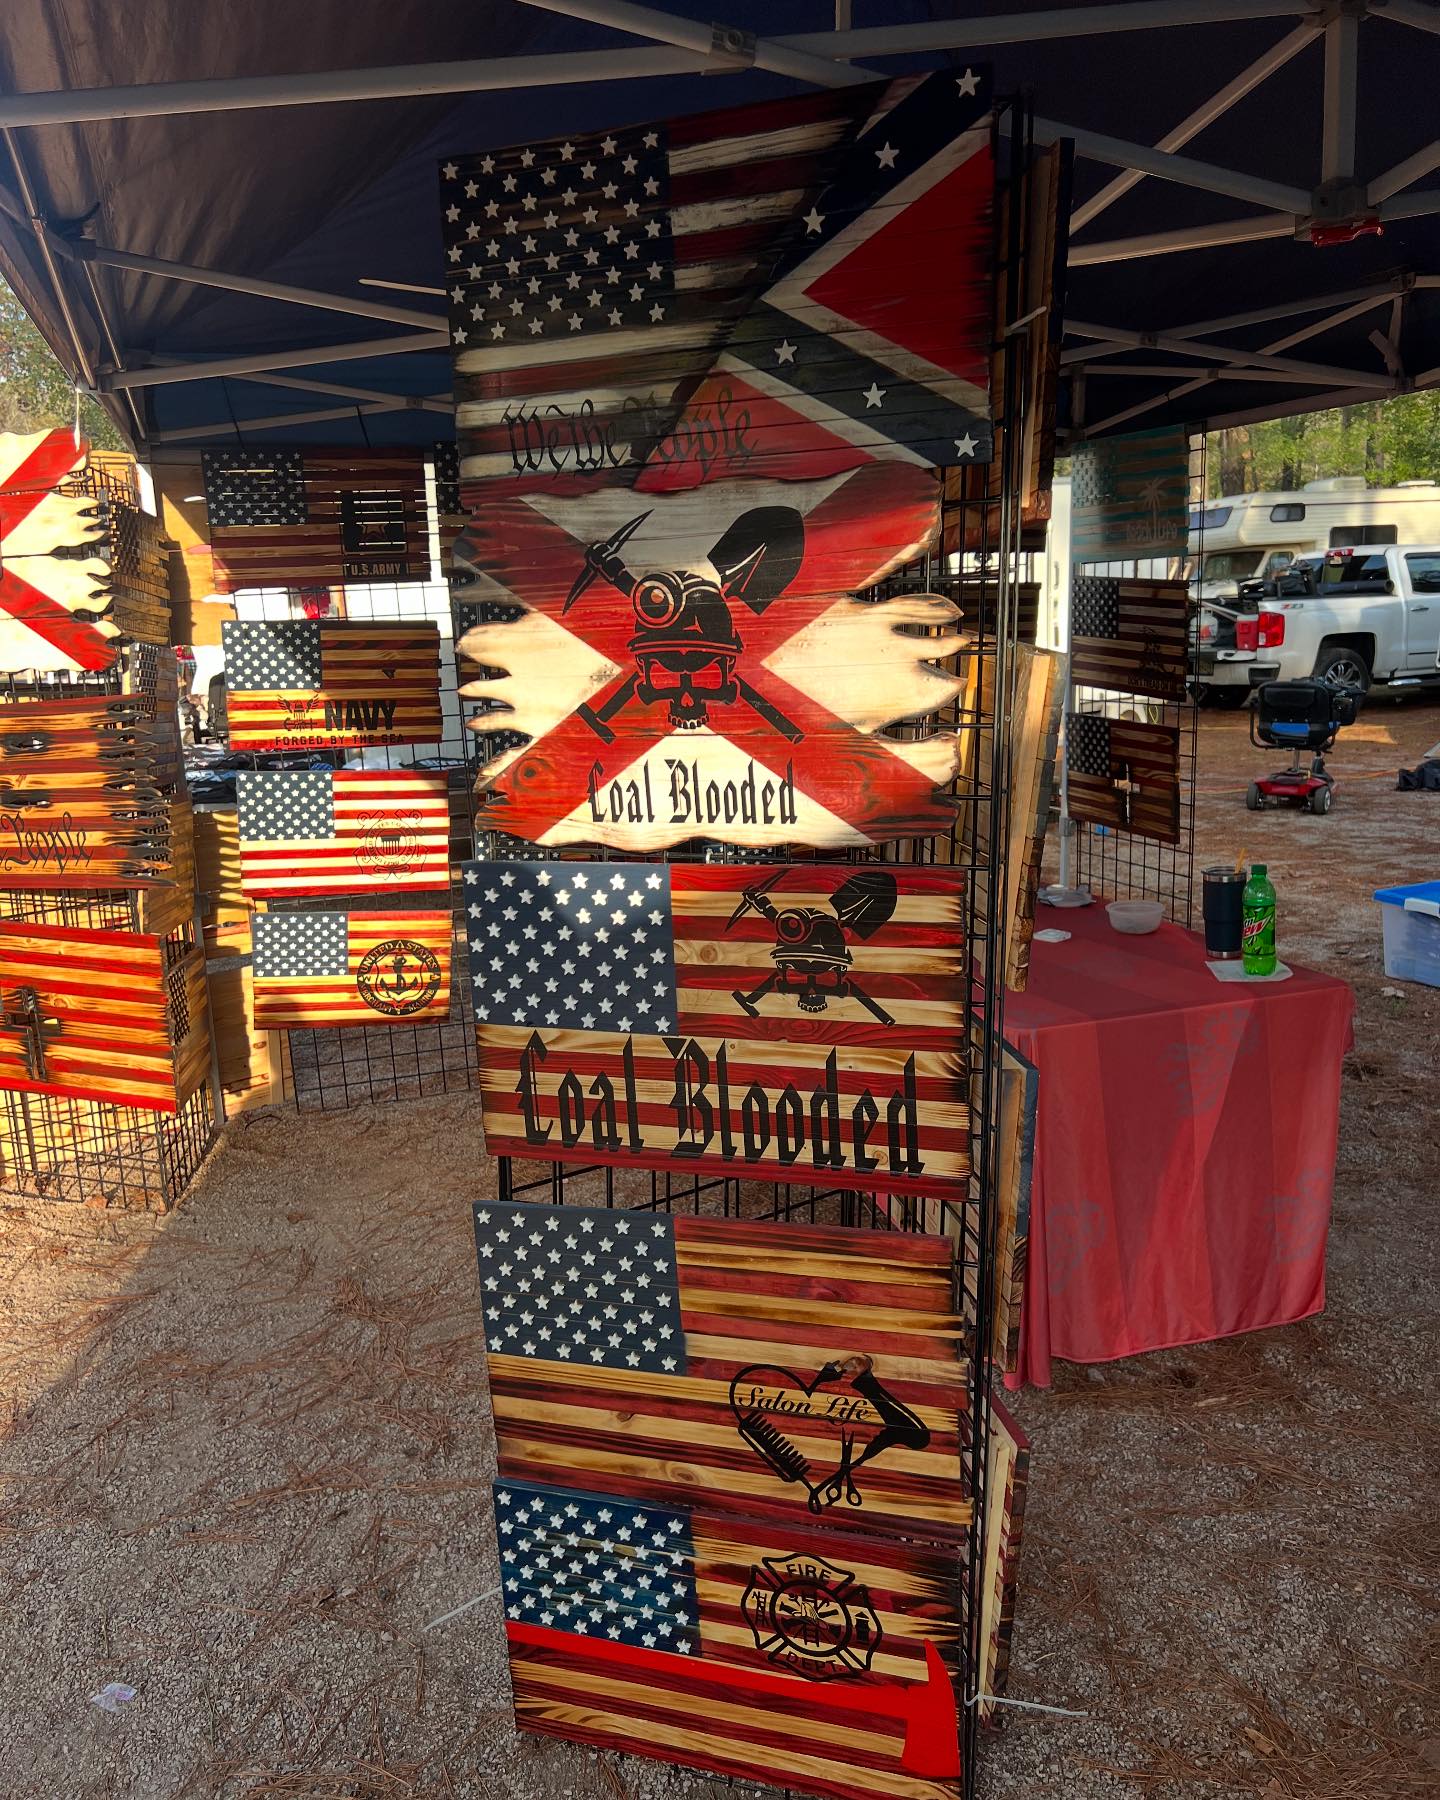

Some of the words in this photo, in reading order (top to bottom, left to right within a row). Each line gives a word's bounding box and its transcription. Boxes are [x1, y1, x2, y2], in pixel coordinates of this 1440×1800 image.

[500, 402, 570, 481] We
[546, 399, 628, 480] the
[324, 699, 397, 731] NAVY
[275, 736, 323, 745] FORGED
[330, 735, 345, 744] BY
[352, 734, 374, 743] THE
[381, 733, 404, 743] SEA
[586, 758, 655, 823] Coal
[664, 757, 798, 824] Blooded
[0, 811, 94, 879] People
[360, 942, 393, 972] UNITED
[406, 942, 438, 969] STATES
[515, 1029, 644, 1154] Coal
[662, 1036, 926, 1178] Blooded
[739, 1386, 815, 1414] Salon
[816, 1395, 872, 1426] Life
[786, 1563, 832, 1582] FIRE
